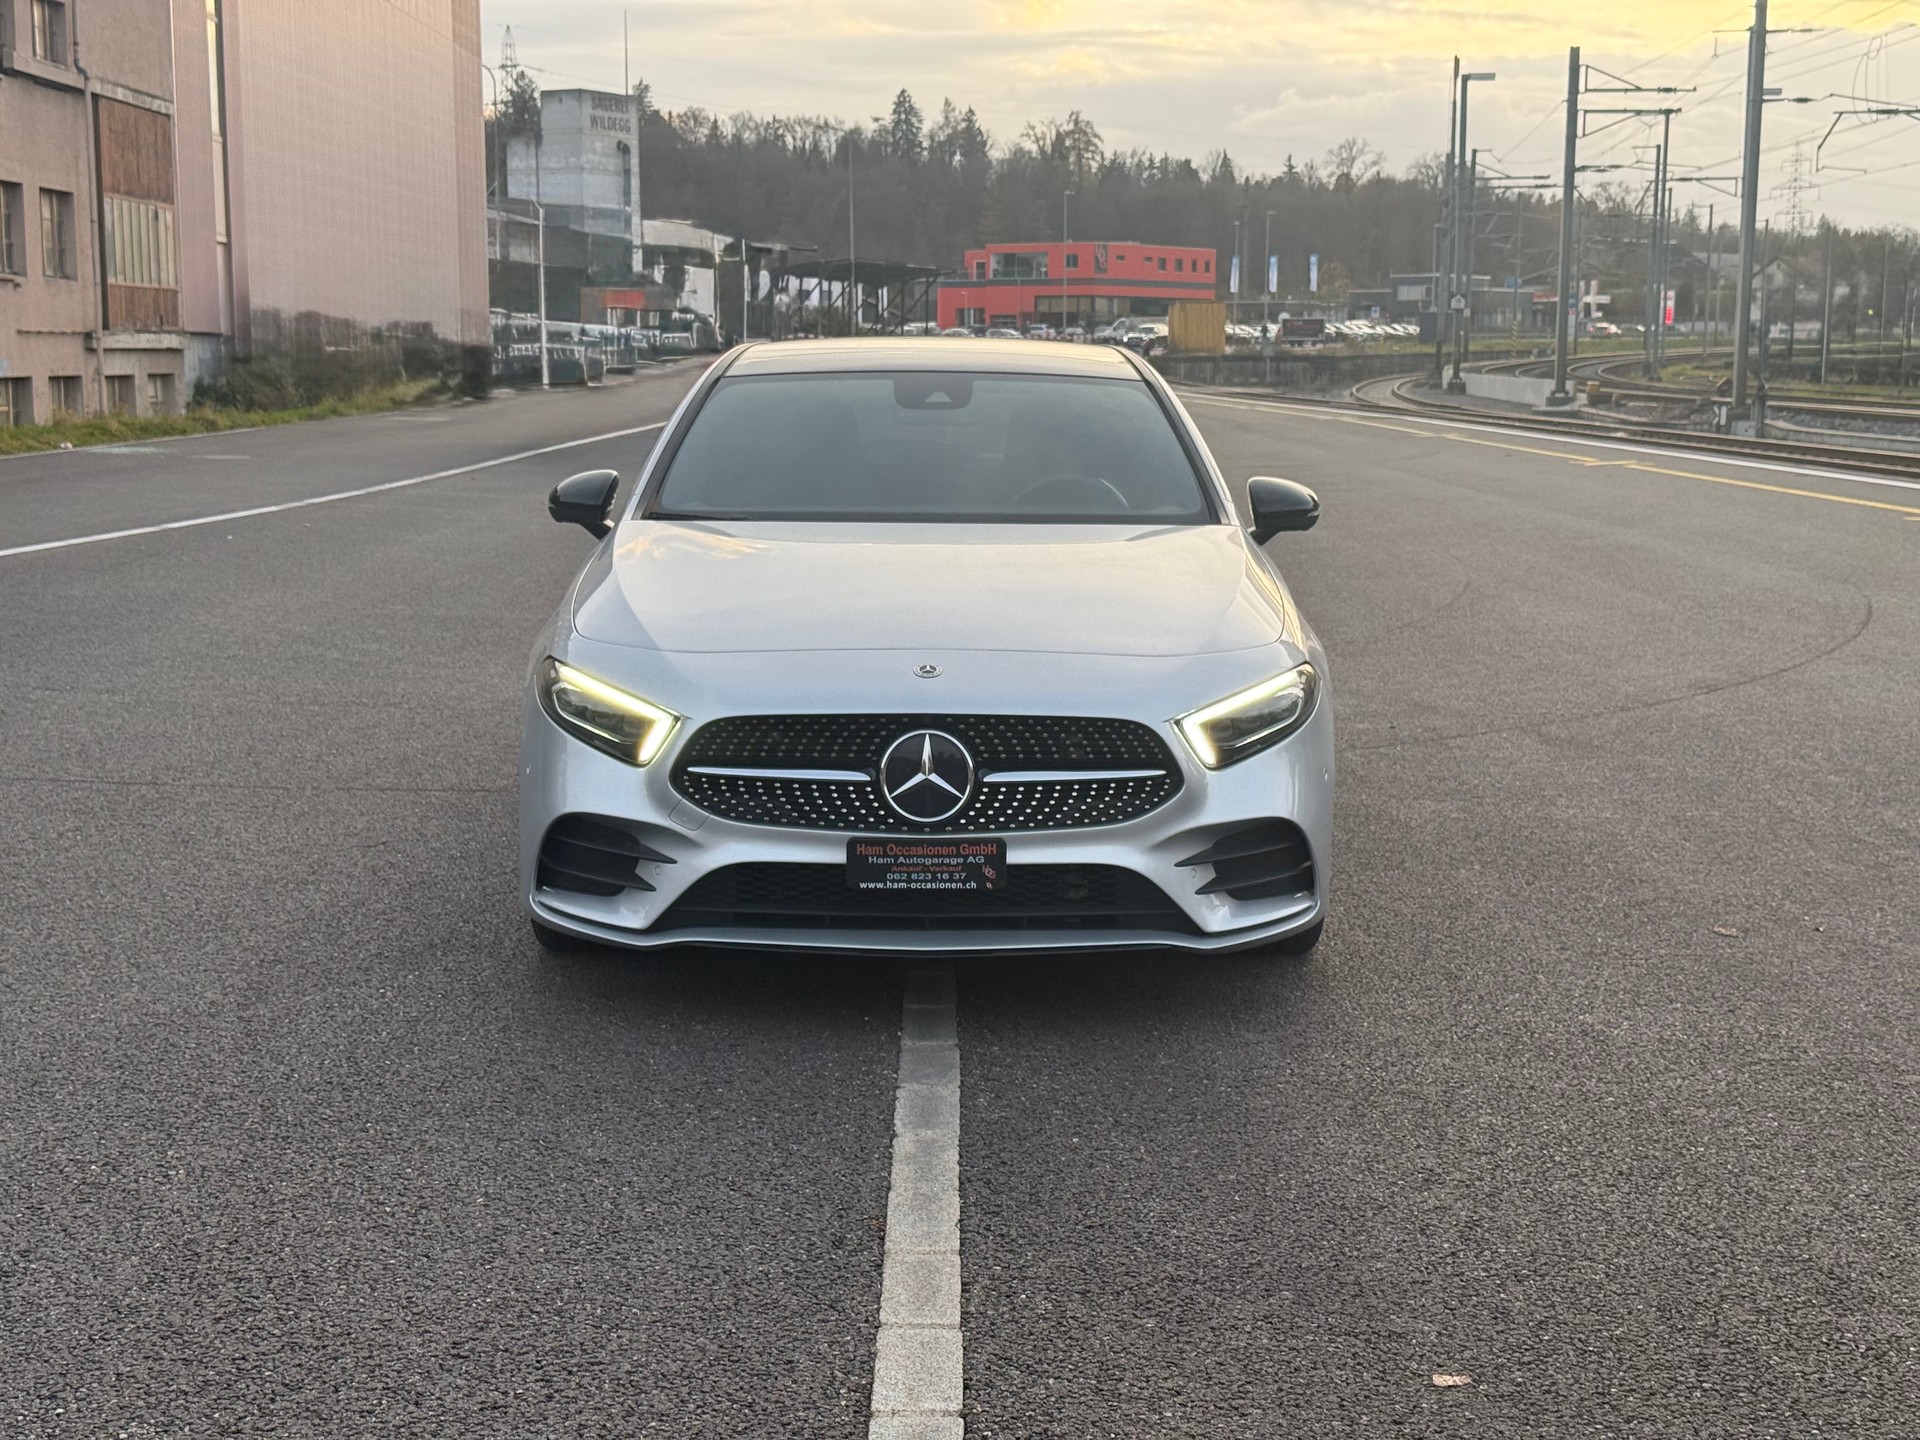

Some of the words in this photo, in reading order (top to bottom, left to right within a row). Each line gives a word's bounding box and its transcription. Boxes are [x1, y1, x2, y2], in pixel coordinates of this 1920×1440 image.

[590, 115, 631, 133] WILDEGG
[856, 843, 883, 855] Ham
[886, 843, 957, 855] Occasionen
[959, 843, 997, 855] GmbH
[868, 856, 894, 864] Ham
[897, 856, 964, 865] Autogarage
[966, 856, 985, 864] AG
[886, 872, 908, 880] 062
[911, 872, 932, 880] 823
[936, 872, 949, 880] 16
[952, 872, 967, 880] 37
[859, 881, 977, 890] www.ham-occasionen.ch
